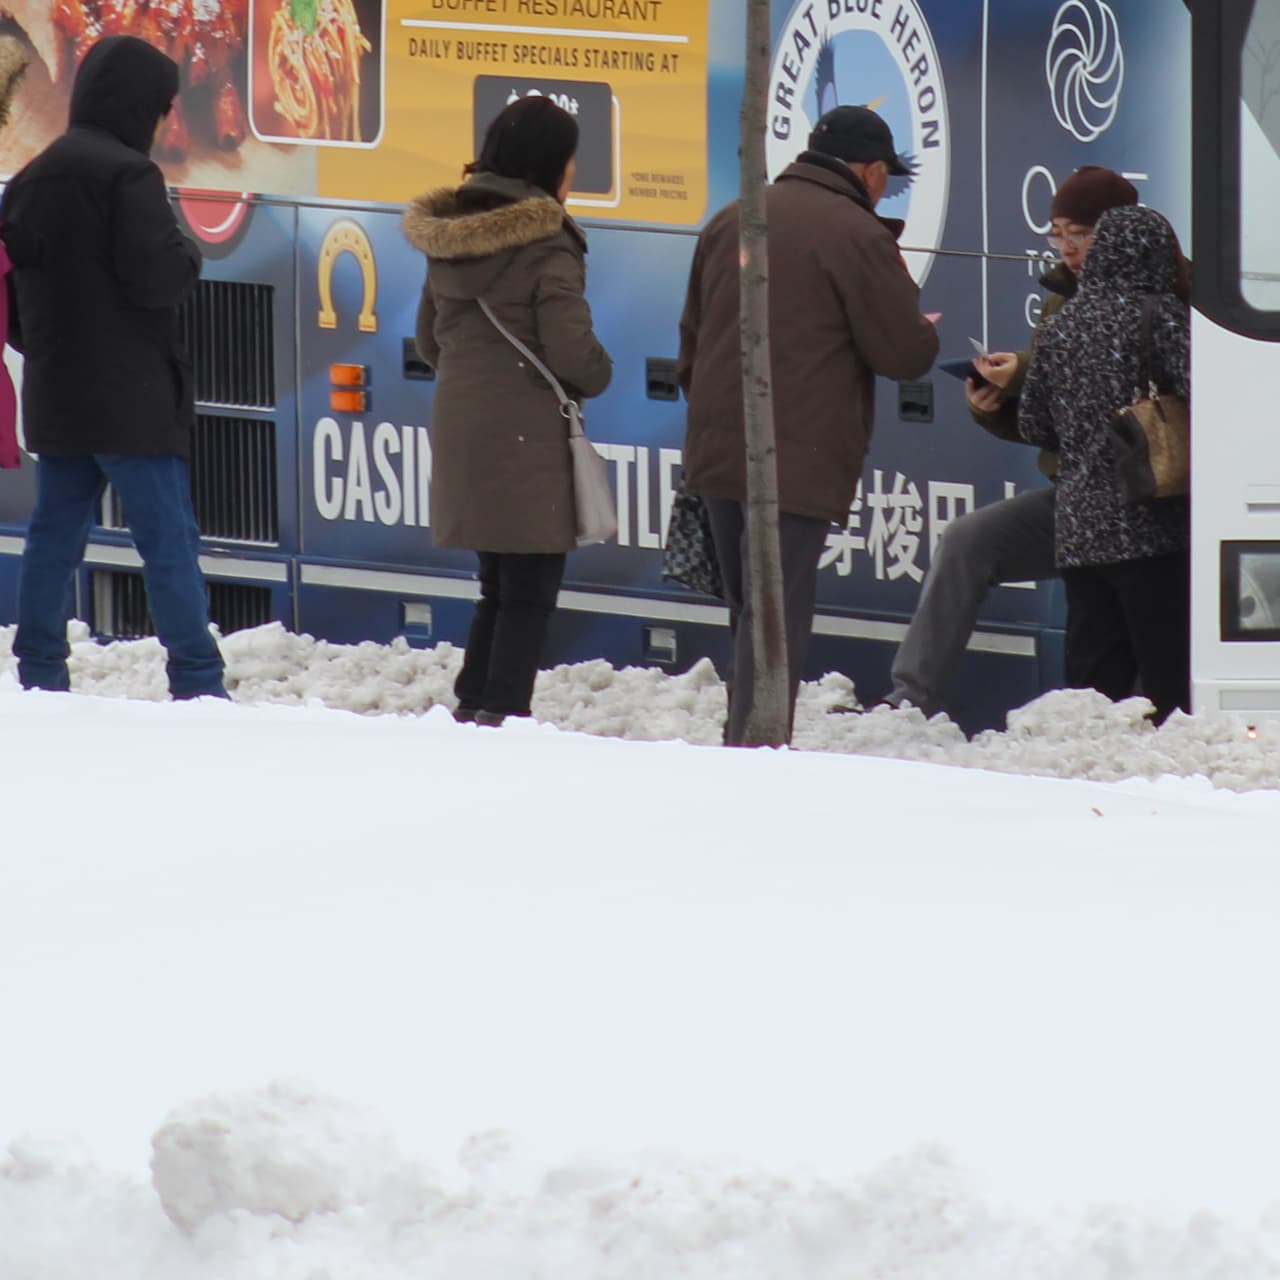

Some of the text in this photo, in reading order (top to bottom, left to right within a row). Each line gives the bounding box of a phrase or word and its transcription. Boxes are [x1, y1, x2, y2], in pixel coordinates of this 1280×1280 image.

[408, 38, 680, 73] DAILY BUFFET SPECIALS STARTING AT
[772, 3, 818, 141] GREAT
[890, 4, 940, 149] HERON
[313, 417, 431, 527] CASI
